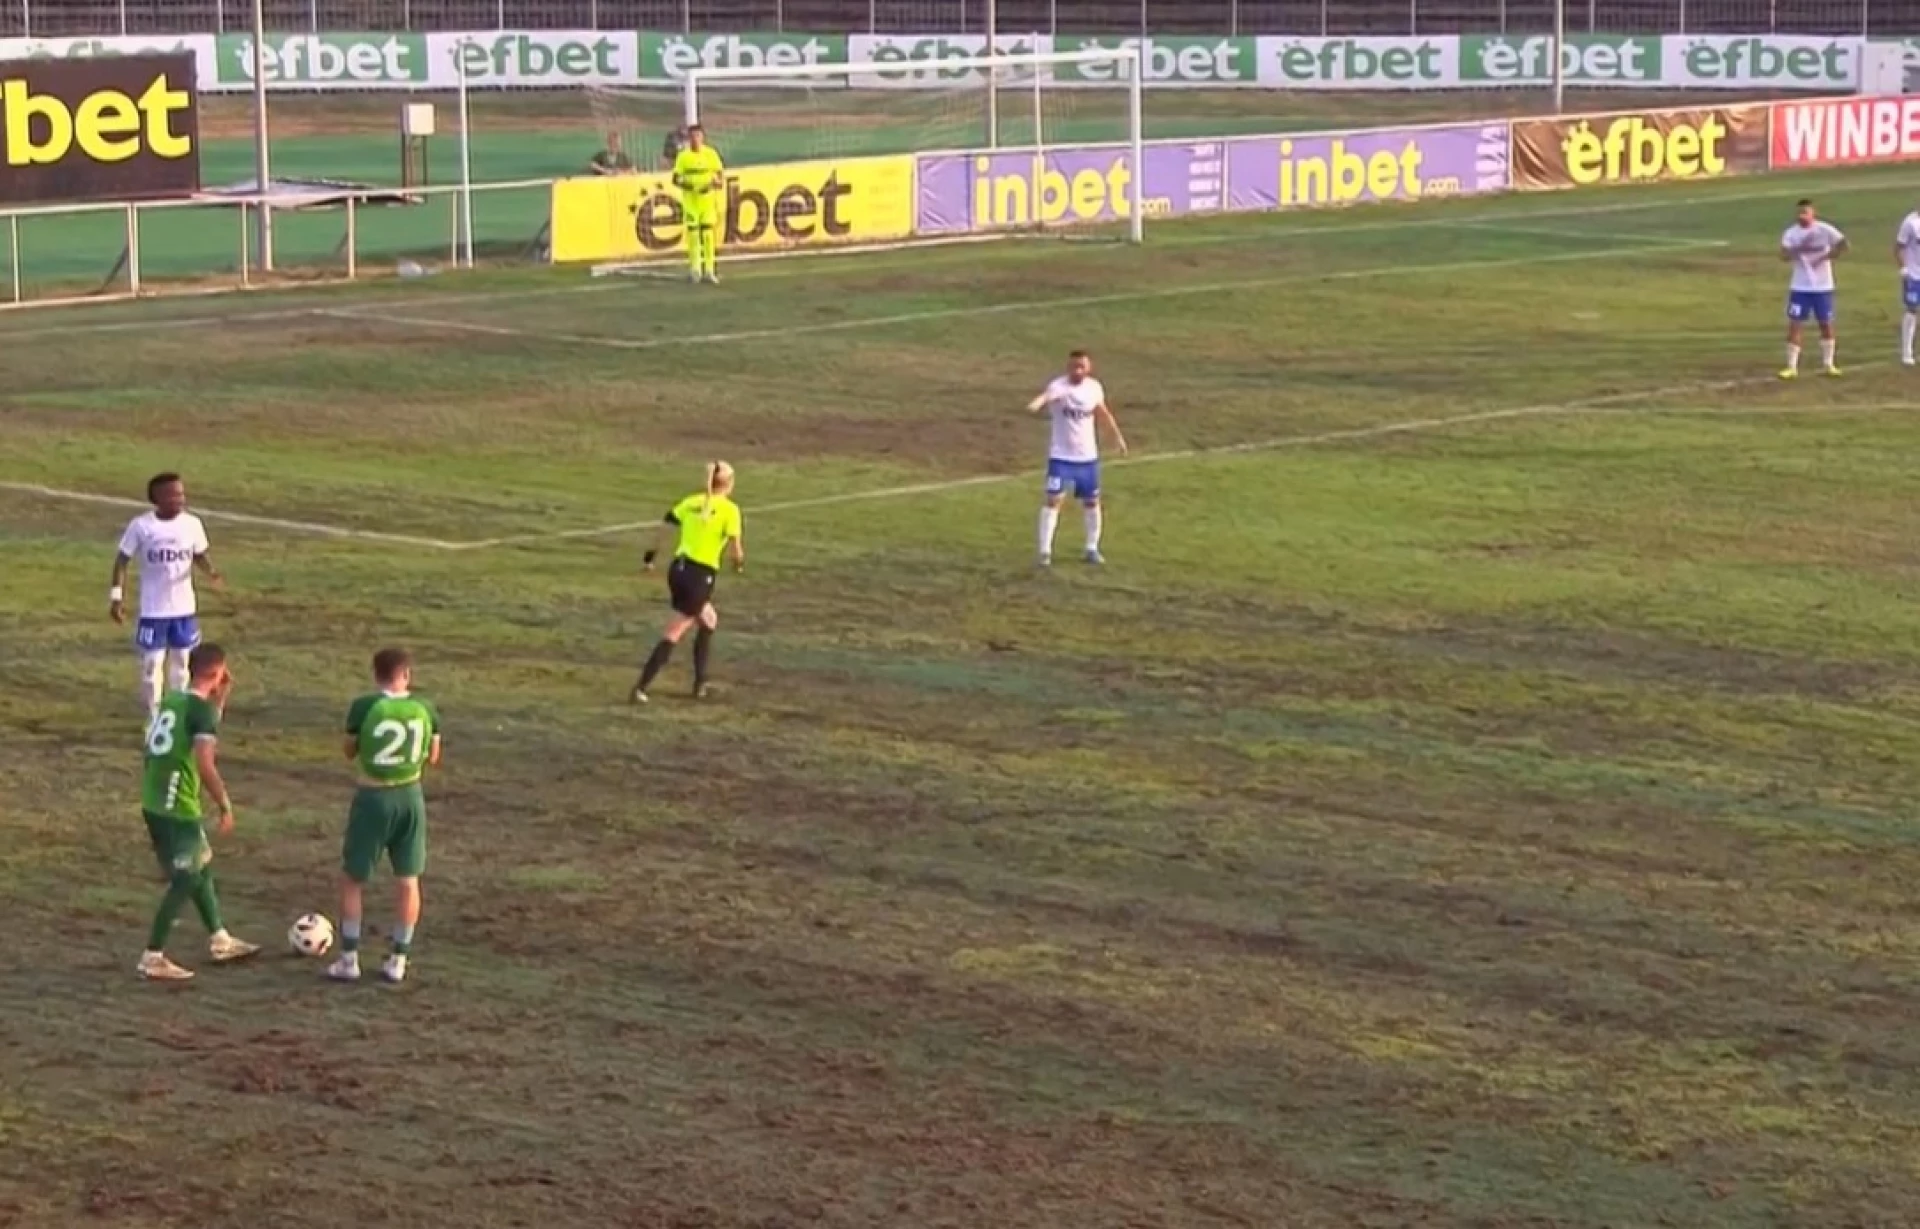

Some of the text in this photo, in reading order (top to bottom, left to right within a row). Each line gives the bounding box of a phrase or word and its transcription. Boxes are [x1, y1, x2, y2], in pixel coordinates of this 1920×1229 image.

[449, 34, 620, 77] efbet
[1277, 39, 1442, 80] efbet
[1683, 39, 1848, 80] efbet
[0, 73, 191, 165] bet
[1562, 113, 1725, 183] efbet
[975, 156, 1132, 226] inbet
[1279, 140, 1422, 207] inbet
[630, 168, 852, 250] ebet
[373, 718, 424, 765] 21
